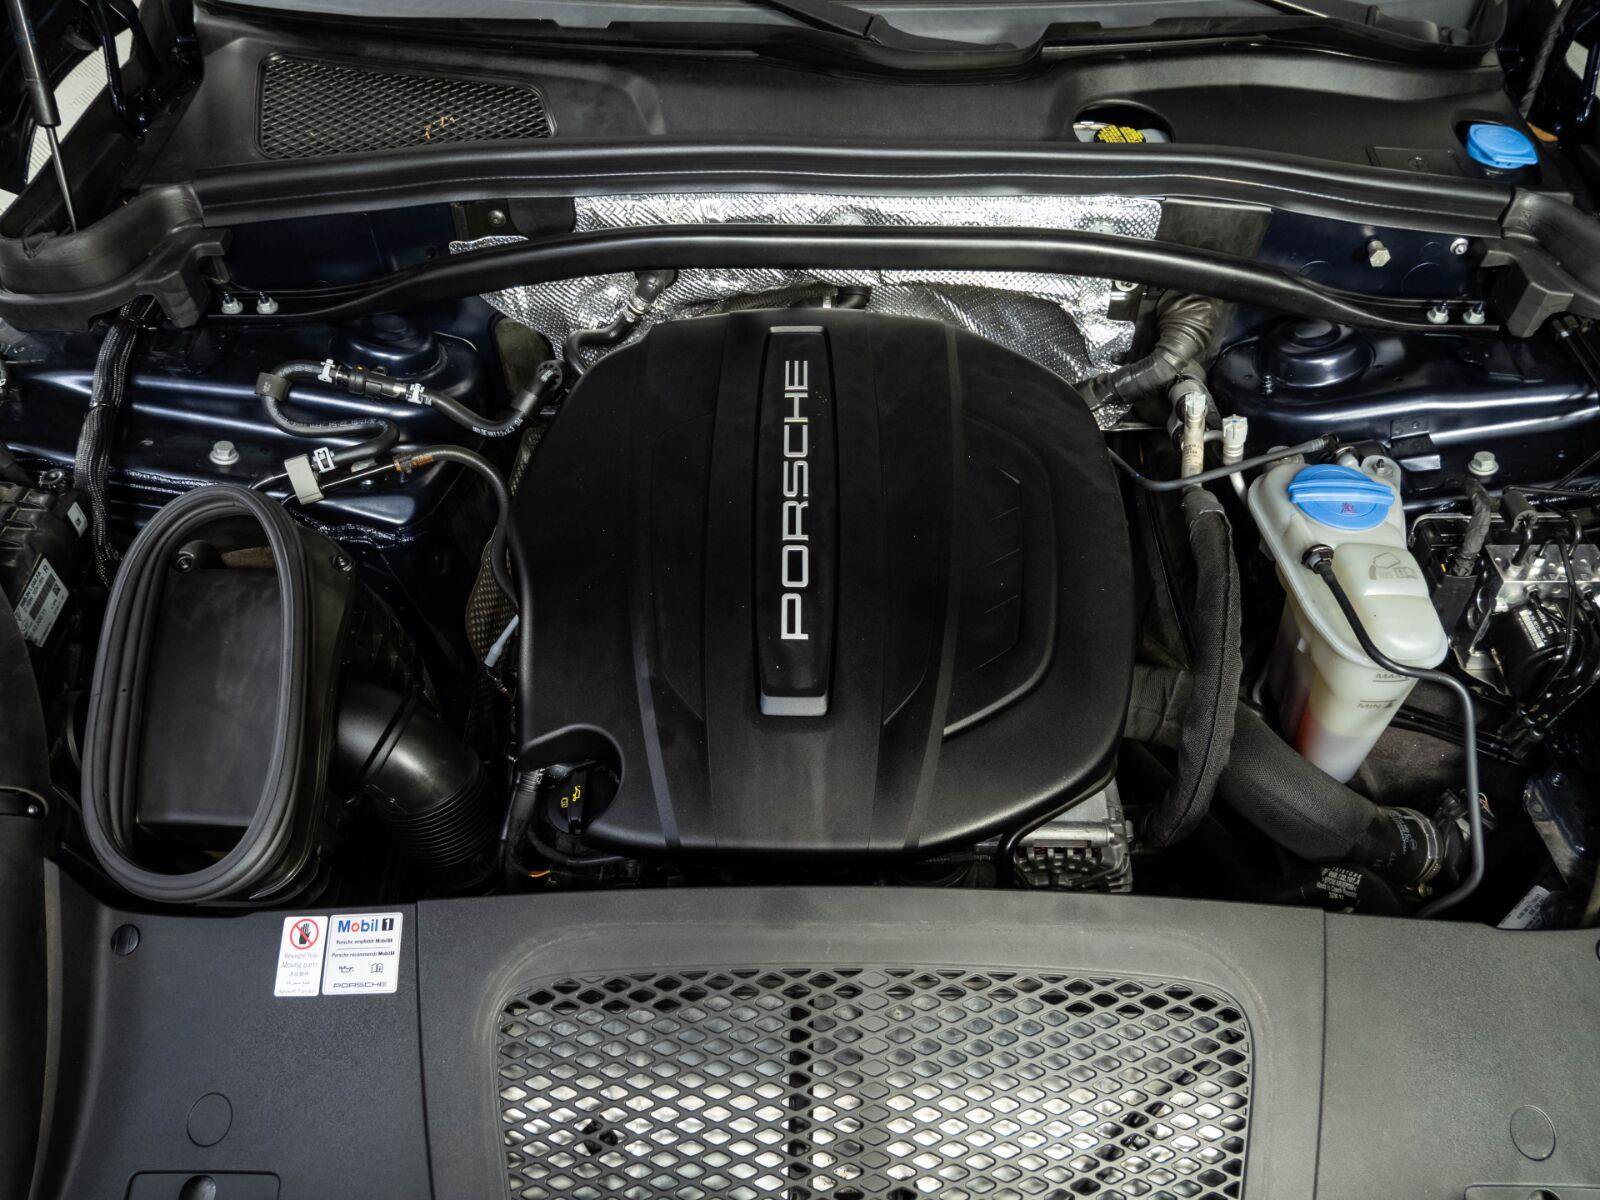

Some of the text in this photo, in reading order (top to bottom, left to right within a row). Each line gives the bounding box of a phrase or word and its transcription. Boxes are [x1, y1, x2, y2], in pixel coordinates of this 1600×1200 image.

[781, 360, 809, 640] PORSCHE
[337, 918, 379, 933] Mobil
[281, 961, 318, 969] Moving parts
